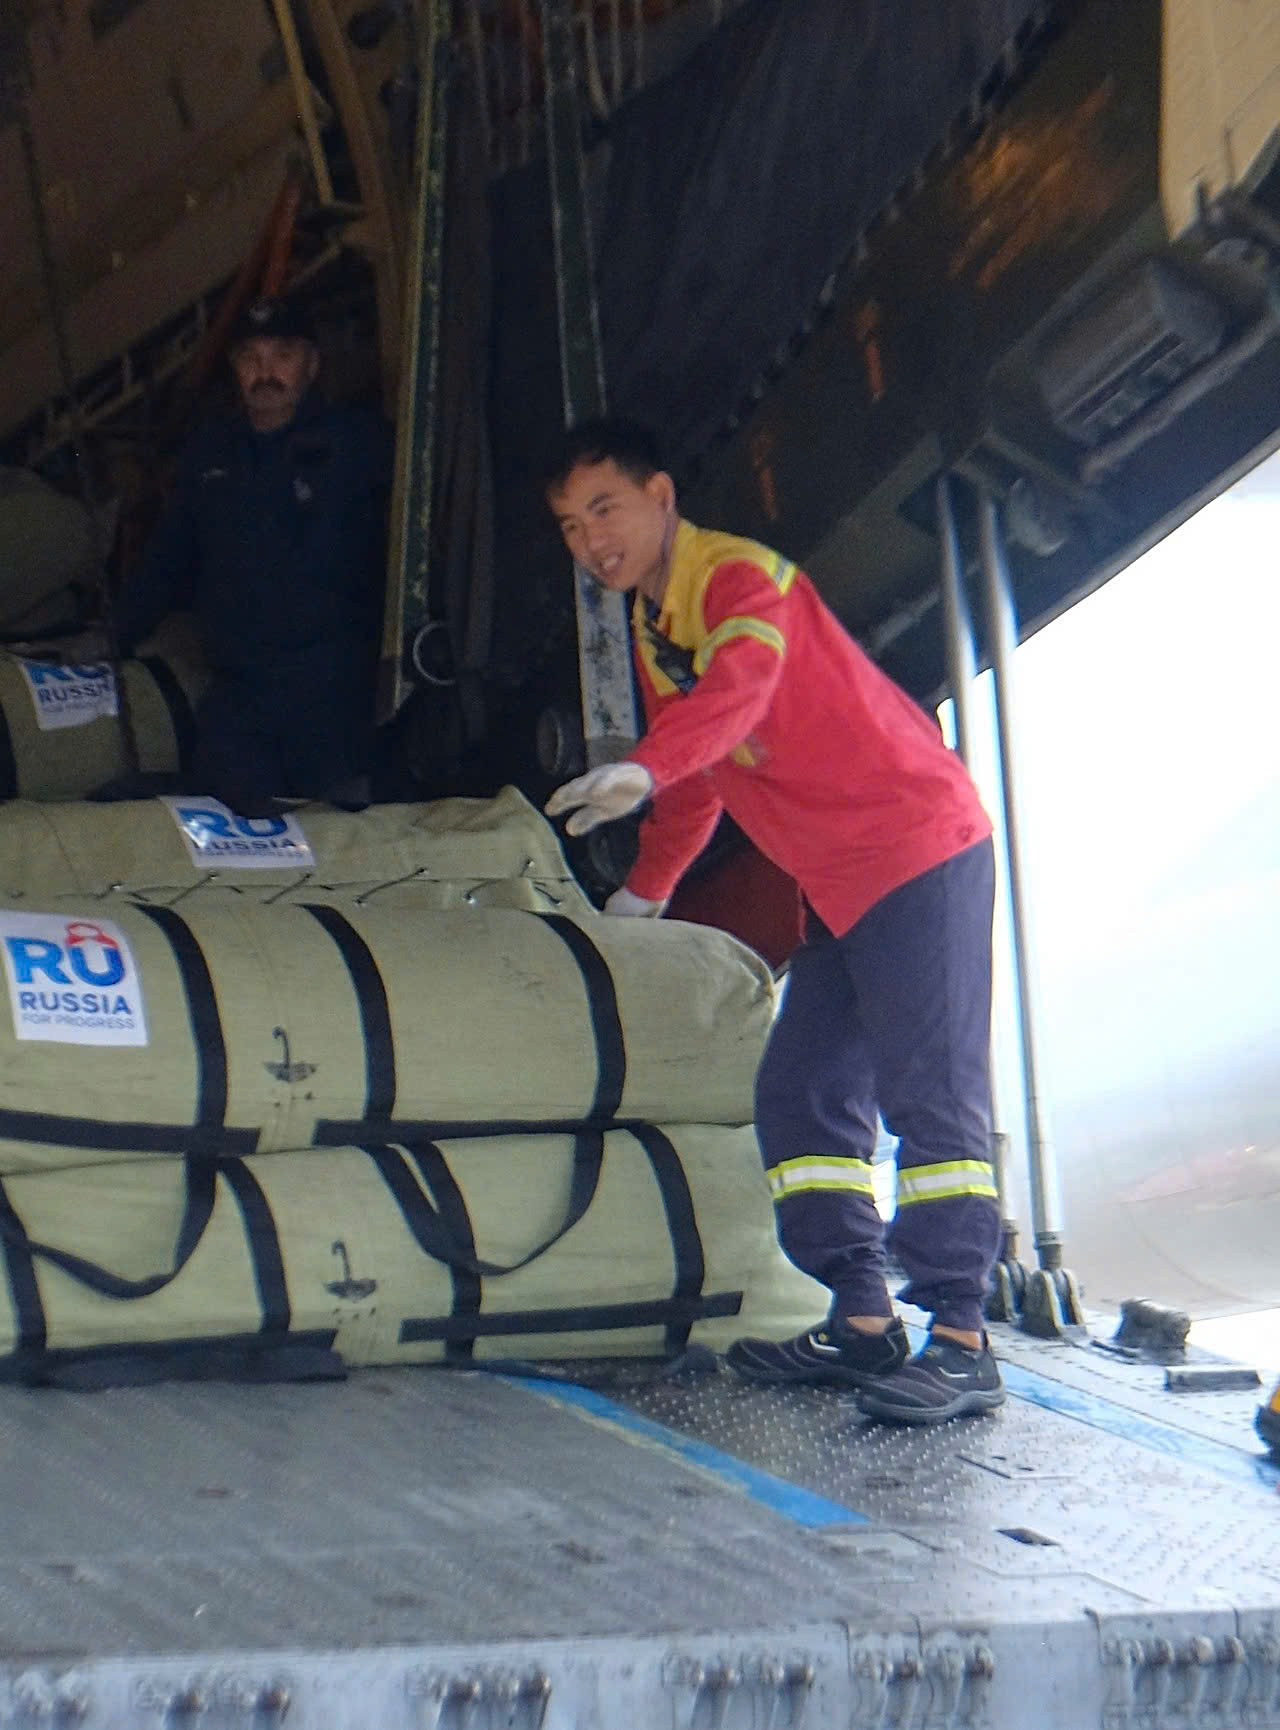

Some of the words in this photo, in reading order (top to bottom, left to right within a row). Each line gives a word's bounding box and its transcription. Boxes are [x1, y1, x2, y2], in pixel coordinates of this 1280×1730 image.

[176, 807, 288, 837] RU
[192, 837, 297, 850] USSIA
[6, 936, 125, 986] RU
[19, 992, 132, 1015] RUSSIA
[22, 1013, 51, 1025] FOR
[55, 1015, 136, 1029] PROGRESS
